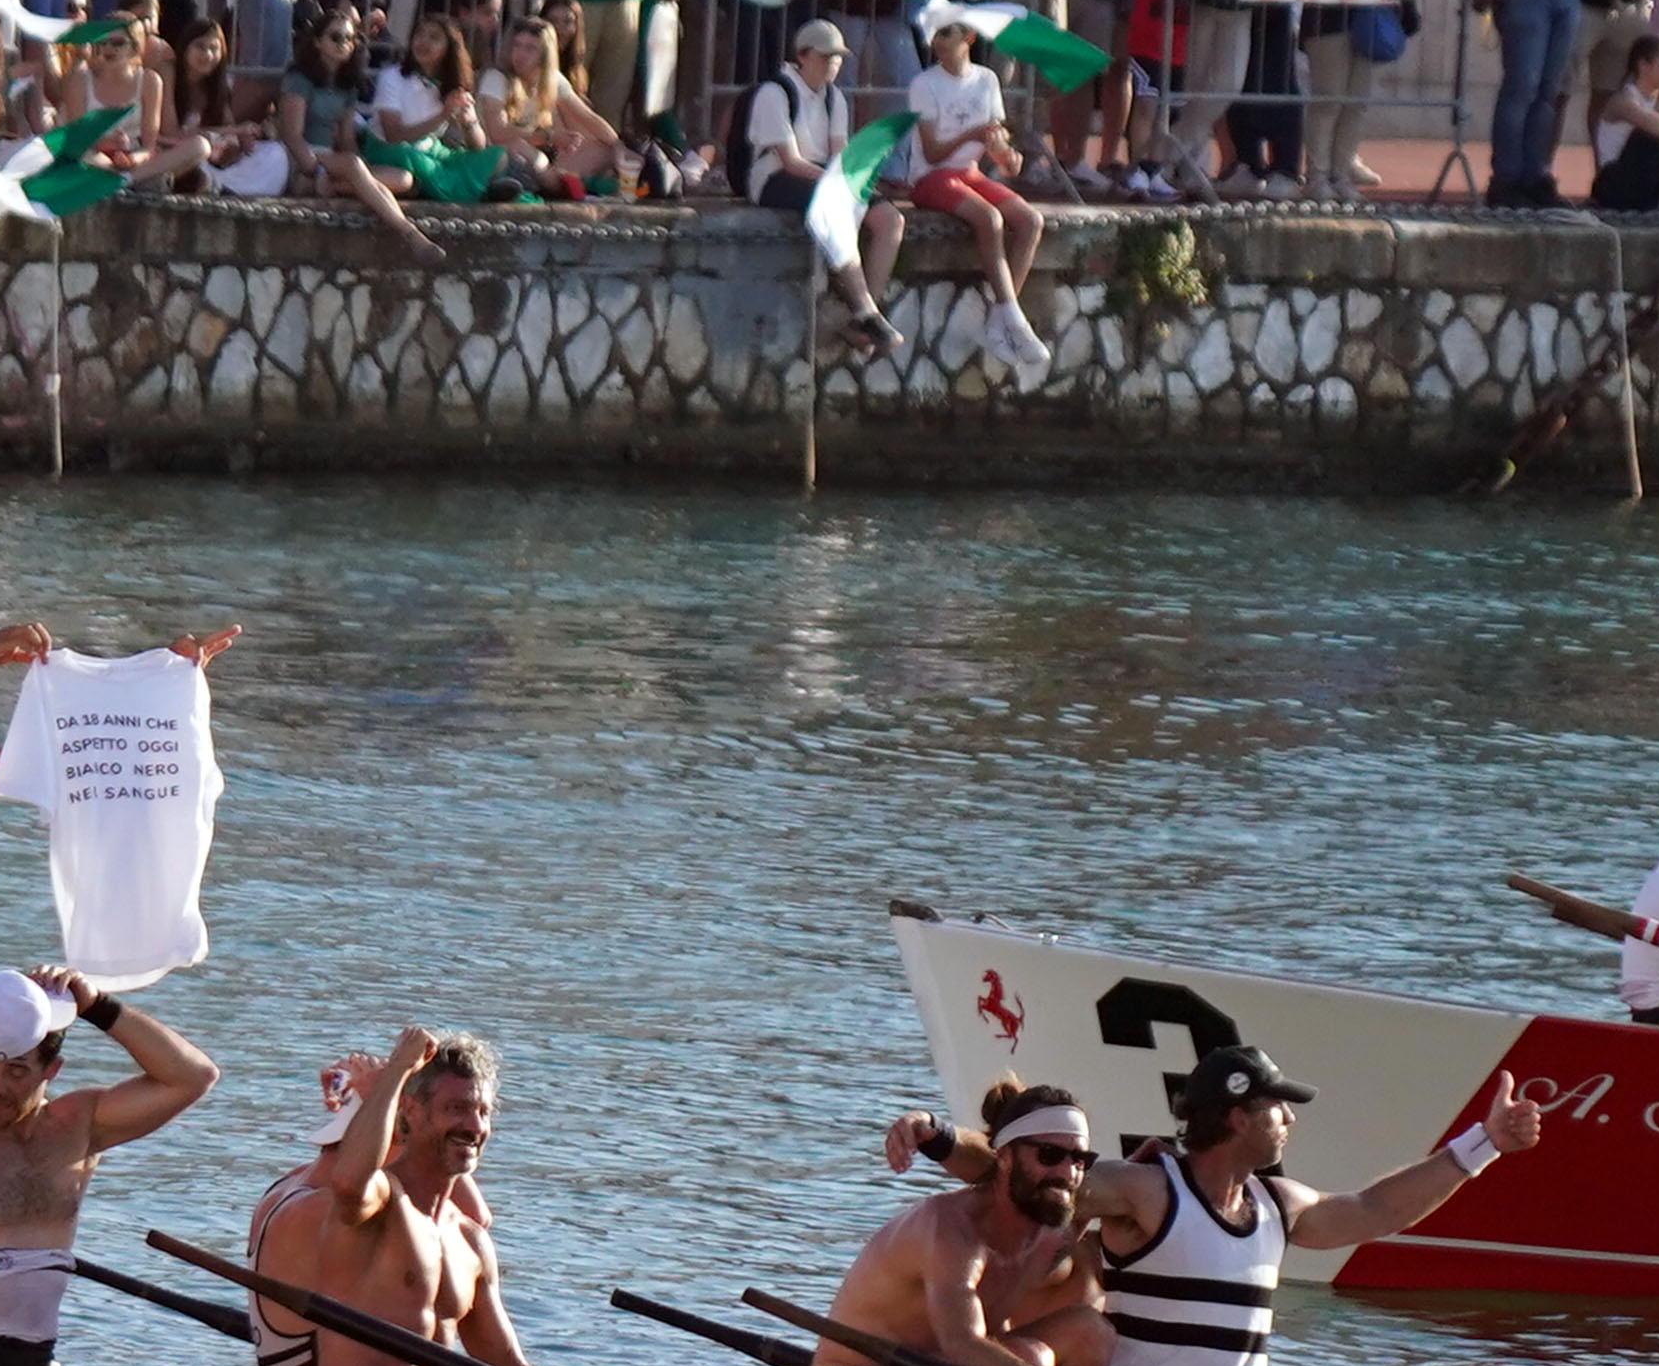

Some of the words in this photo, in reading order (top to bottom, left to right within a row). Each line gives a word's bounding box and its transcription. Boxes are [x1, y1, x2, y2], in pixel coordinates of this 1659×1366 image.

[56, 716, 79, 730] DA
[81, 714, 100, 726] 18
[103, 714, 141, 728] ANNI
[145, 717, 178, 731] CHE
[62, 737, 127, 754] ASPETTO
[137, 740, 179, 753] OGGI
[133, 763, 179, 776] NERO
[104, 785, 180, 801] SANGUE
[1518, 1073, 1614, 1124] A.
